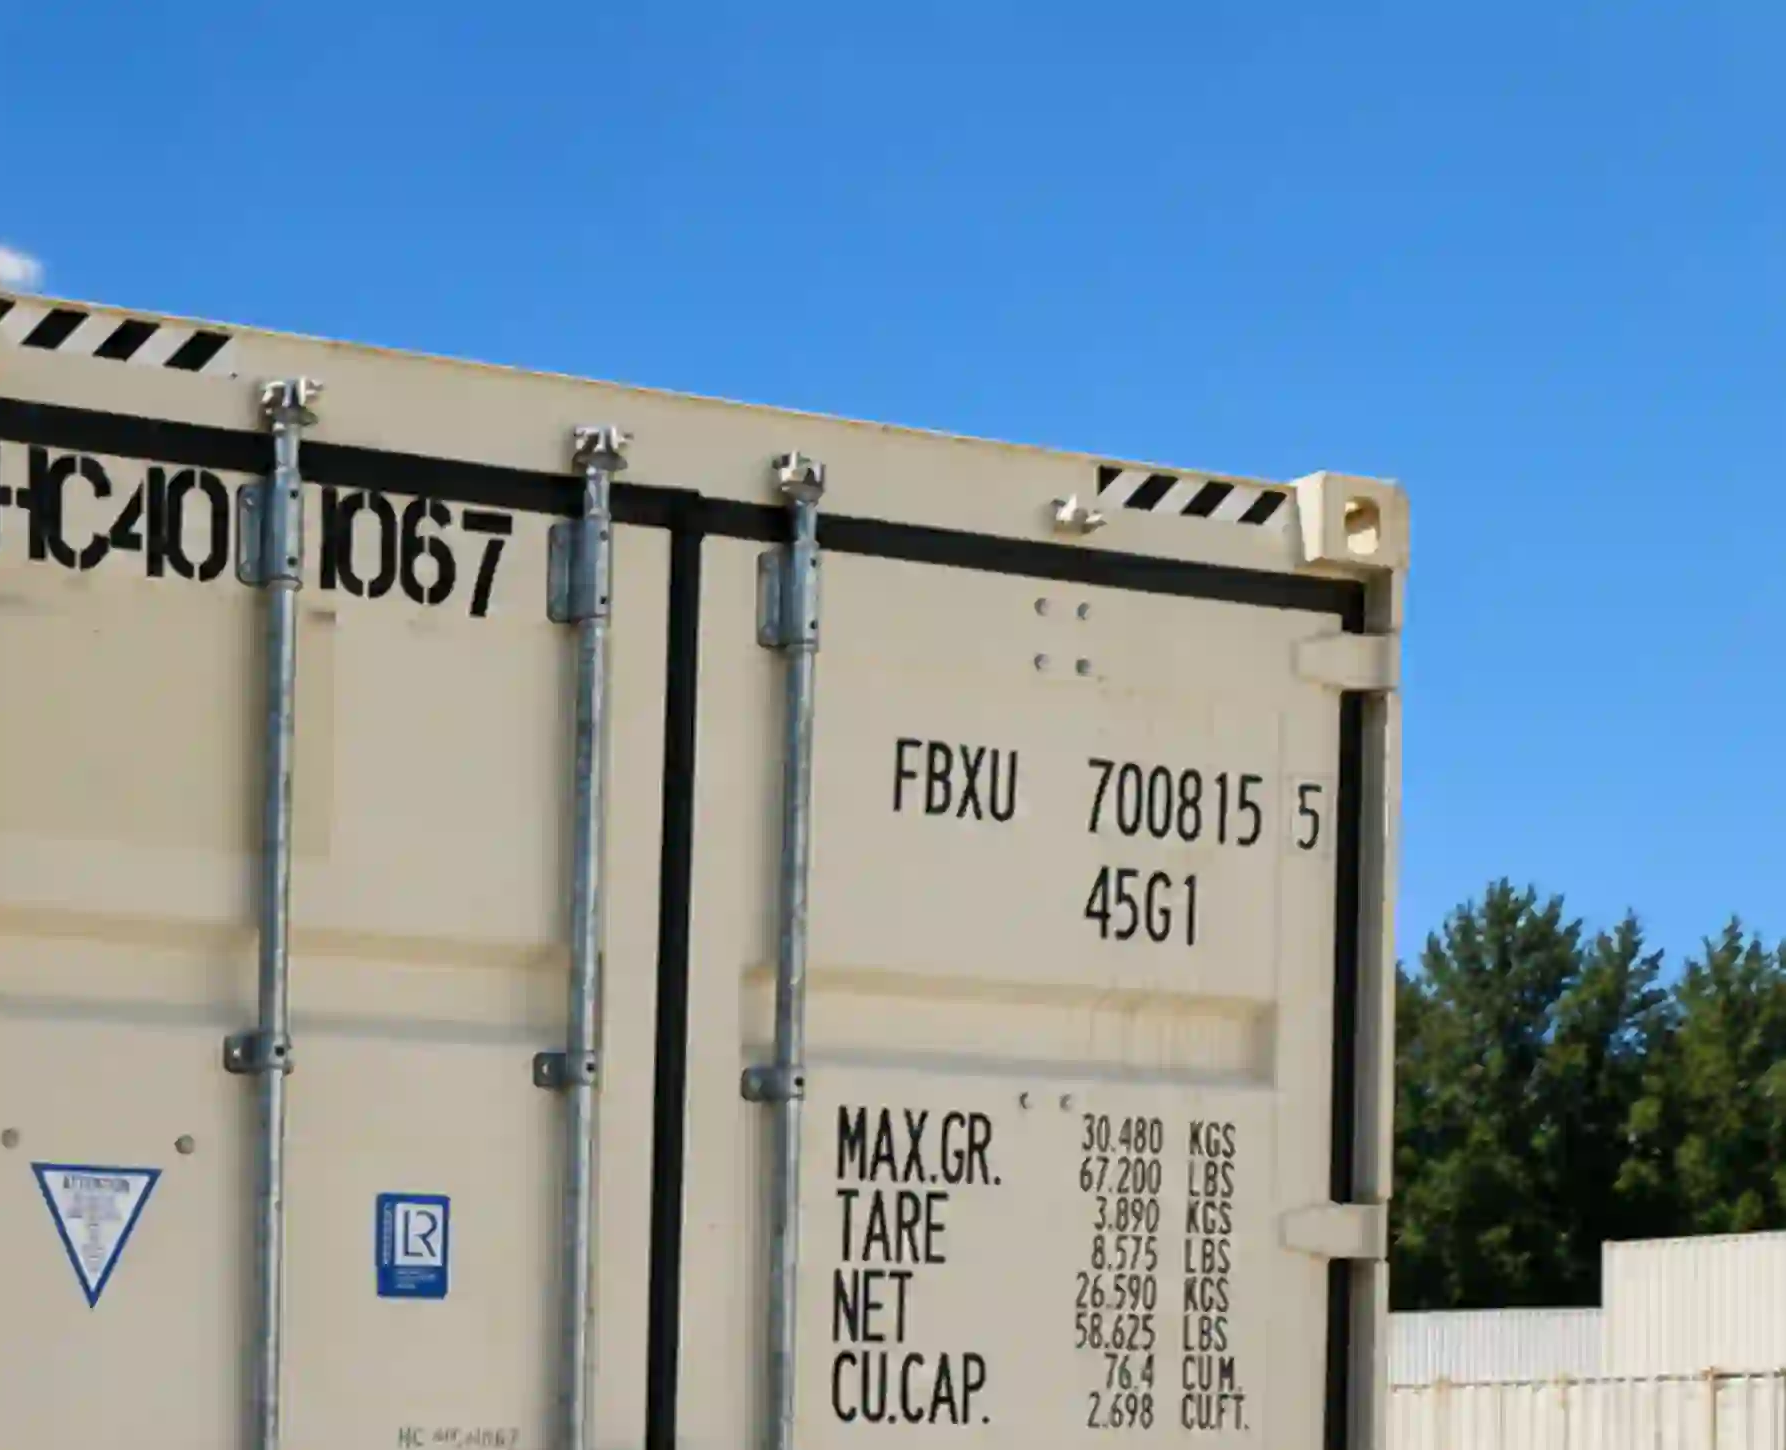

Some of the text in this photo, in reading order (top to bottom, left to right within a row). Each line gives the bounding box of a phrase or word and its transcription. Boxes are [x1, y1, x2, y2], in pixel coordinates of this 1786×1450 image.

[892, 737, 1324, 850] FBXU 700815 5
[1083, 865, 1198, 947] 45G1
[836, 1105, 1237, 1186] MAX.GR. 30.480 KGS
[1079, 1155, 1236, 1199] 67.200 LBS
[836, 1188, 1234, 1264] TARE 3.890 KGS
[1091, 1234, 1232, 1275] 8.575 LBS
[831, 1268, 1230, 1344] NET 26.590 KGS
[1075, 1312, 1228, 1352] 58.625 LBS
[830, 1350, 991, 1425] CU.CAP.
[1087, 1391, 1155, 1430] 2.698
